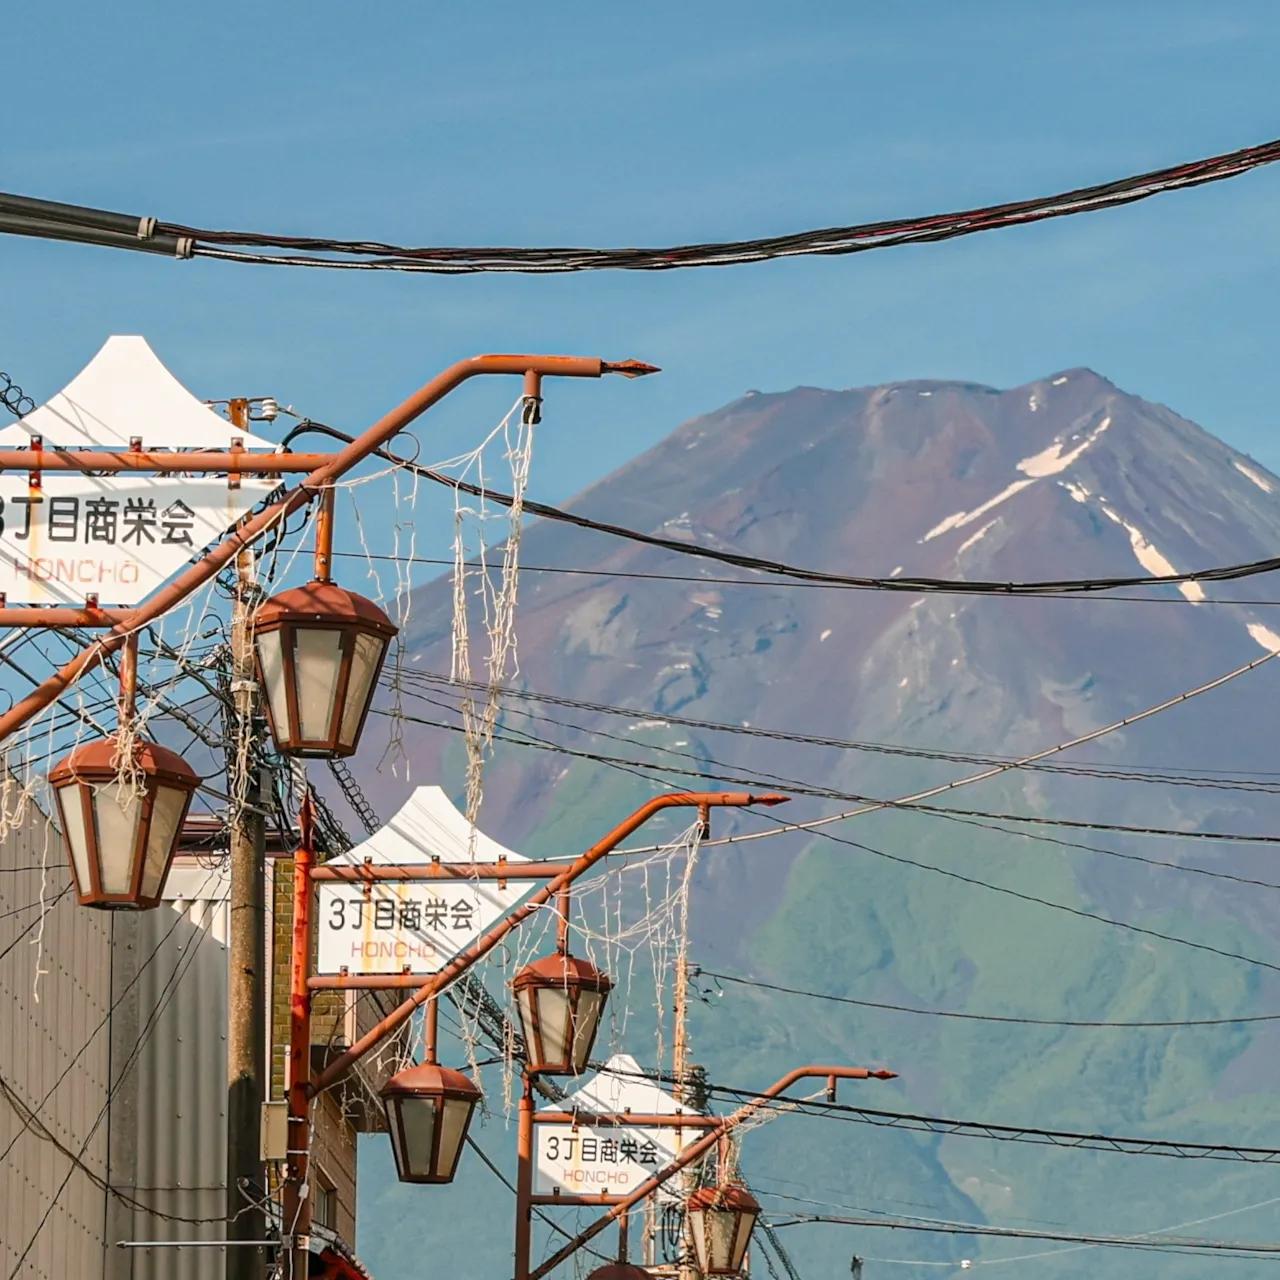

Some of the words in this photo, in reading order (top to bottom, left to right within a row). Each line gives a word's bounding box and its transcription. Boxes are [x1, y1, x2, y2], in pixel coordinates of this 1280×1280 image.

[329, 898, 474, 931] 3丁目商栄会
[546, 1136, 658, 1165] 3丁目商栄会
